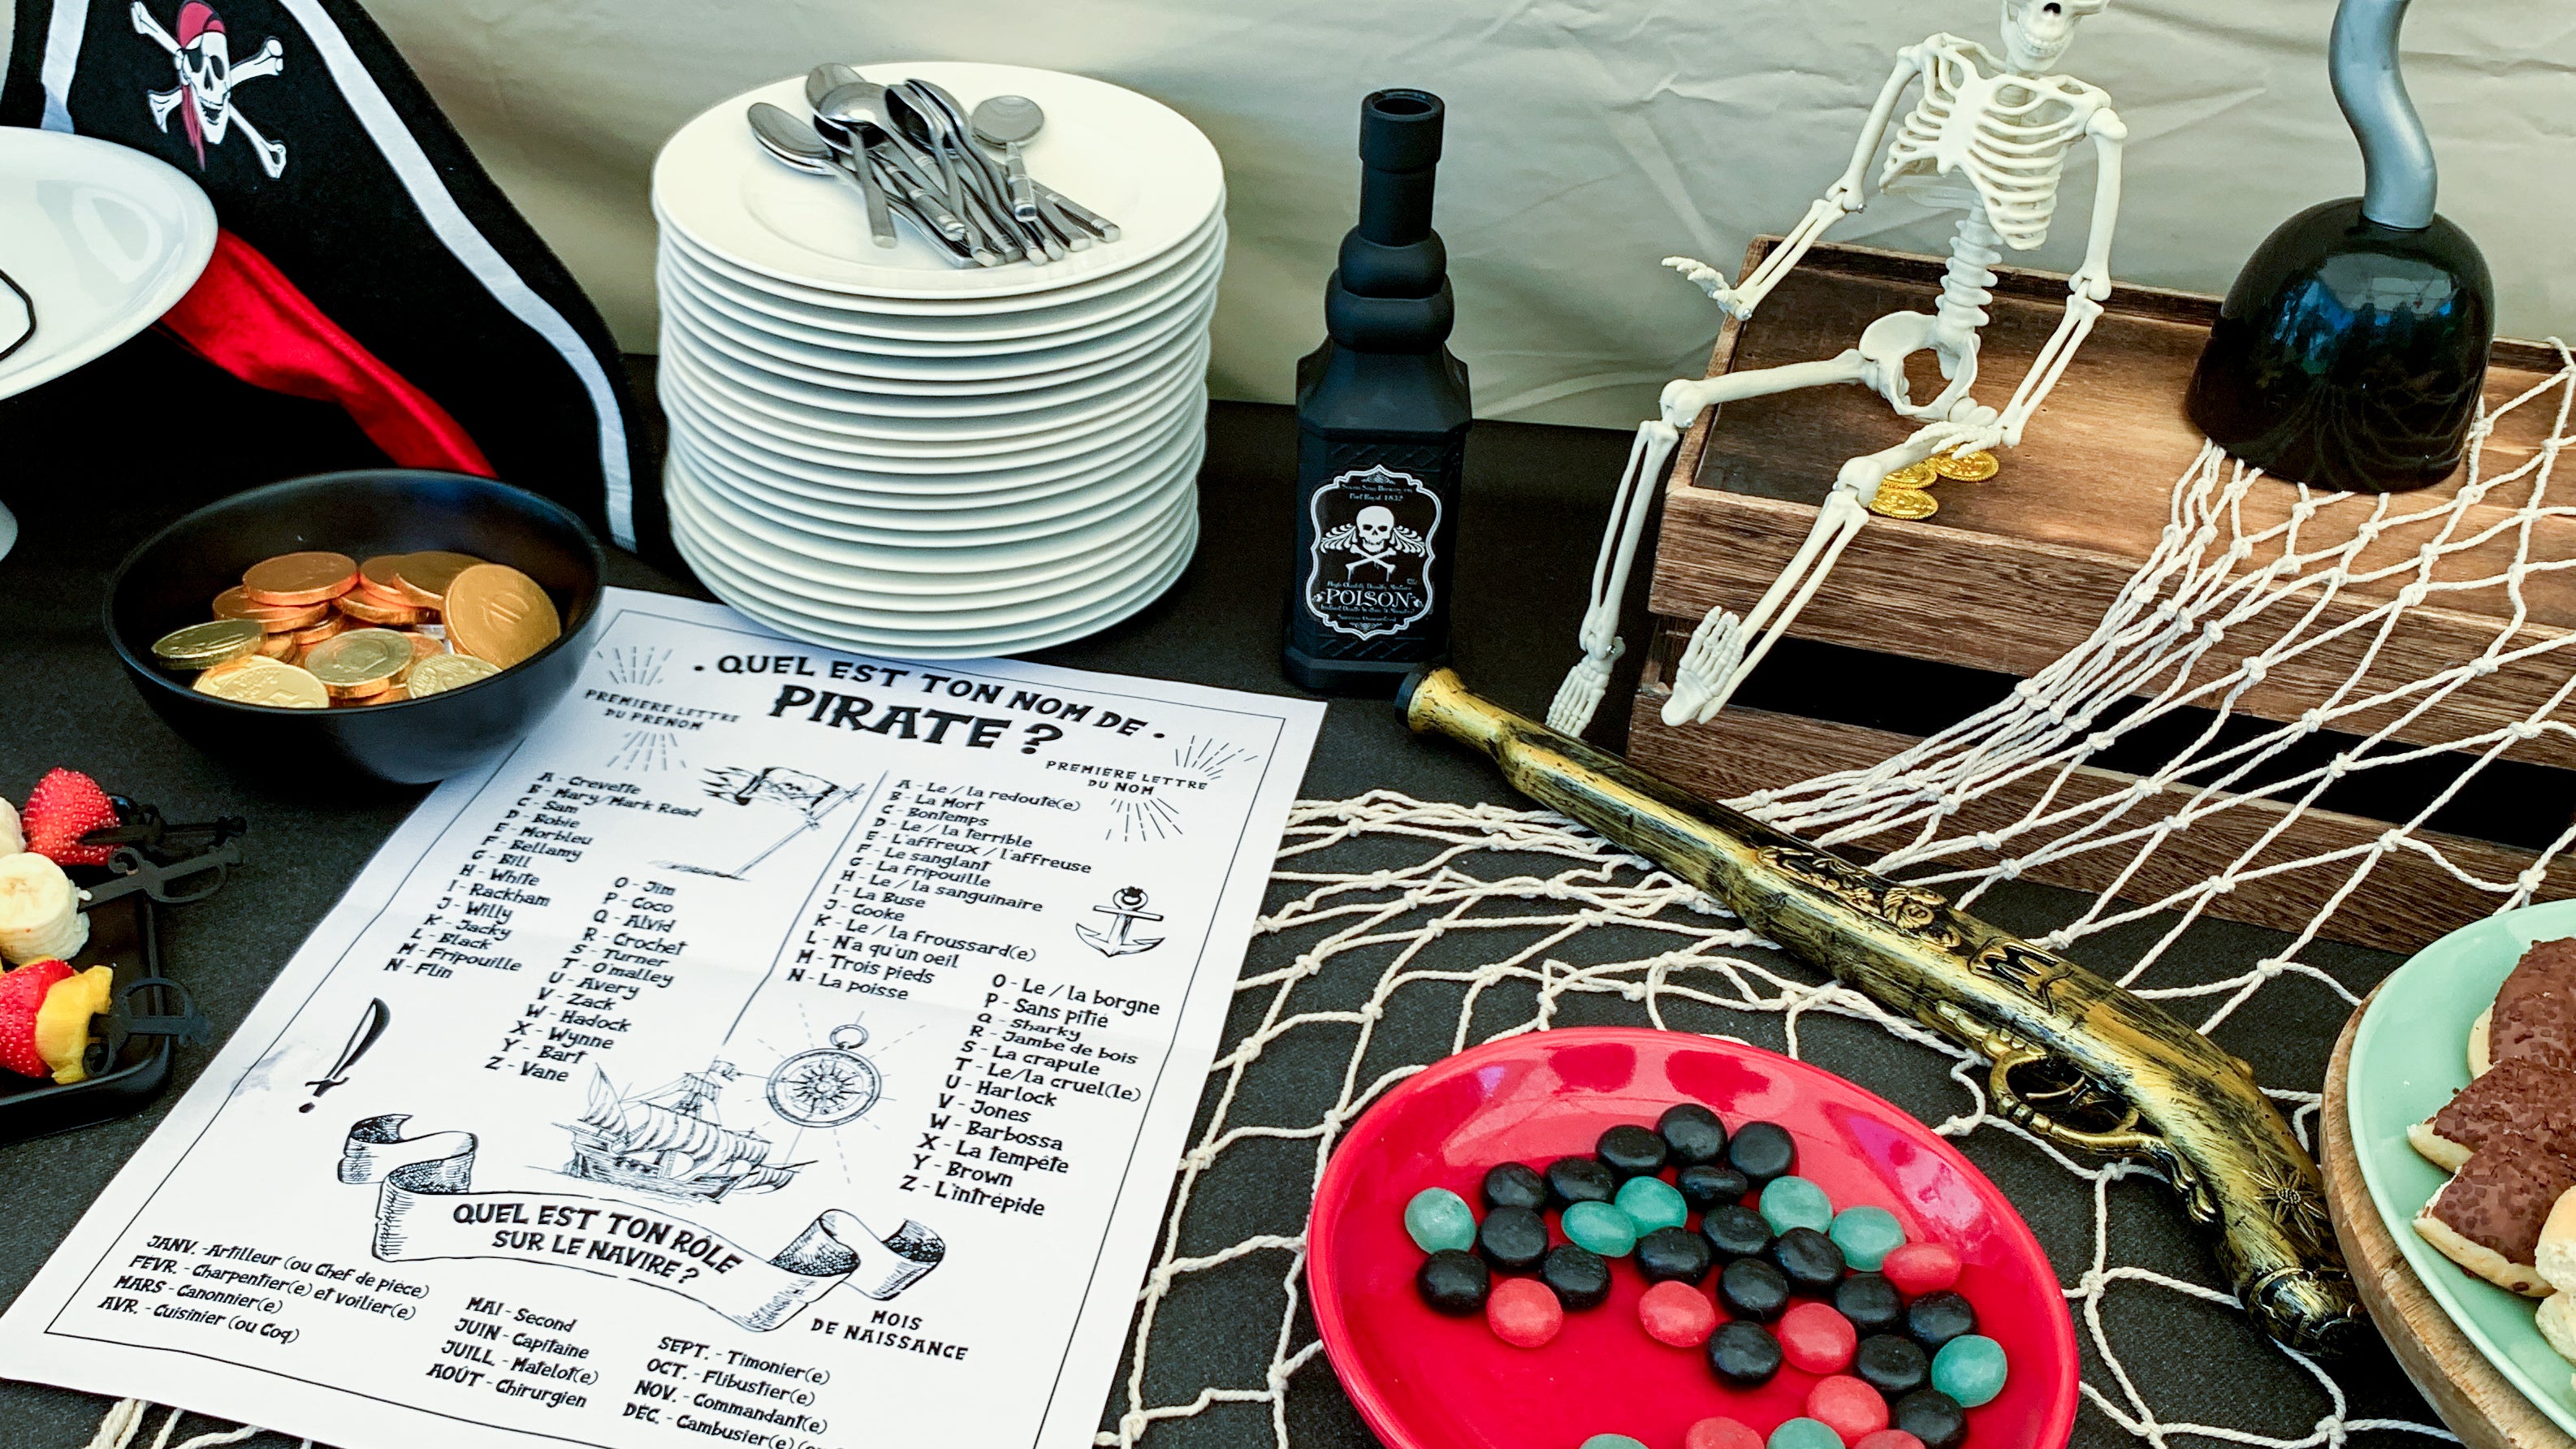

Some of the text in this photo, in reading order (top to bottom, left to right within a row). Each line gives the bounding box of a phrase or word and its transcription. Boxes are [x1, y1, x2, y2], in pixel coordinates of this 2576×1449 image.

[1325, 588, 1412, 608] POISON
[718, 655, 1148, 737] QUEL EST TON NOM DE
[604, 708, 625, 720] DU
[676, 706, 741, 722] LETTRE
[767, 684, 1012, 749] PIRATE
[568, 776, 641, 794] Crevette
[927, 782, 947, 793] Le
[966, 786, 984, 798] la
[1087, 780, 1155, 795] DU NOM
[1142, 773, 1208, 790] LETTRE
[542, 801, 579, 814] Sam
[914, 794, 986, 811] La Mort
[906, 807, 990, 827] Bontemps
[520, 826, 593, 846] Morbleu
[900, 820, 1033, 848] Le la terrible
[497, 854, 532, 867] Bill
[508, 839, 582, 863] Bellamy
[884, 846, 992, 872] Le sanglant
[891, 833, 1091, 874] L'affreux l'affreuse
[490, 868, 540, 886] White
[876, 860, 991, 887] La fripouille
[469, 883, 551, 906] Rackham
[642, 880, 676, 895] Jim
[853, 887, 927, 909] La Buse
[869, 874, 1044, 912] Le la sanguinaire
[465, 902, 513, 924] Willy
[631, 897, 673, 912] Coco
[851, 903, 905, 922] Cooke
[456, 919, 513, 941] Jacky
[624, 915, 676, 932] Alvid
[438, 933, 493, 949] Black
[613, 932, 688, 955] Crochet
[845, 919, 1036, 962] Le la froussard(e)
[426, 947, 523, 971] Fripouille
[603, 949, 670, 967] Turner
[828, 954, 936, 984] Trois pieds
[923, 952, 961, 968] oeil
[413, 962, 453, 979] Flin
[592, 962, 675, 988] O'malley
[577, 977, 641, 1001] Avery
[818, 973, 909, 1000] La poisse
[1022, 978, 1044, 994] Le
[1067, 985, 1086, 1001] la
[1092, 990, 1160, 1016] borgne
[566, 993, 616, 1010] Zack
[1013, 997, 1060, 1019] Sans
[1064, 1010, 1109, 1027] pitié
[560, 1010, 632, 1032] Hadock
[1009, 1019, 1082, 1041] Sharky
[547, 1027, 614, 1049] Wynne
[1001, 1031, 1065, 1051] Jambe
[1070, 1043, 1092, 1056] de
[1098, 1048, 1139, 1064] bois
[537, 1045, 589, 1064] Bart
[992, 1045, 1017, 1060] La
[1023, 1055, 1100, 1075] crapule
[520, 1061, 569, 1082] Vane
[976, 1080, 1057, 1106] Harlock
[1050, 1079, 1142, 1101] cruel(le)
[970, 1100, 1031, 1122] Jones
[966, 1121, 1063, 1150] Barbossa
[955, 1140, 981, 1158] La
[988, 1146, 1070, 1173] tempête
[946, 1161, 1014, 1187] Brown
[934, 1181, 1045, 1216] L'intrépide
[452, 1203, 745, 1275] QUEL EST TON RÔLE
[146, 1235, 199, 1255] JANV.
[315, 1263, 355, 1282] Chef
[356, 1271, 375, 1286] de
[491, 1231, 545, 1251] SUR
[551, 1234, 585, 1256] LE
[586, 1239, 682, 1278] NAVIRE
[113, 1276, 283, 1314] MARS Canonnier(e)
[192, 1264, 313, 1296] Charpentier(e)
[313, 1287, 335, 1300] et
[334, 1292, 417, 1320] voilier(e)
[101, 1295, 138, 1314] AVR.
[153, 1303, 227, 1326] Cuisinier
[260, 1324, 300, 1343] Coq)
[466, 1297, 578, 1332] MAI Second
[871, 1309, 923, 1330] MOIS
[454, 1317, 590, 1360] JUIN Capitaine
[810, 1318, 969, 1360] DE NAISSANCE
[441, 1339, 599, 1386] JUILL. Matelot(e)
[657, 1336, 831, 1385] SEPT. Timonier(e)
[495, 1379, 587, 1409] Chirurgien
[646, 1358, 816, 1407] OCT. Flibustier(e)
[633, 1381, 828, 1435] NOV. Commandant(e)
